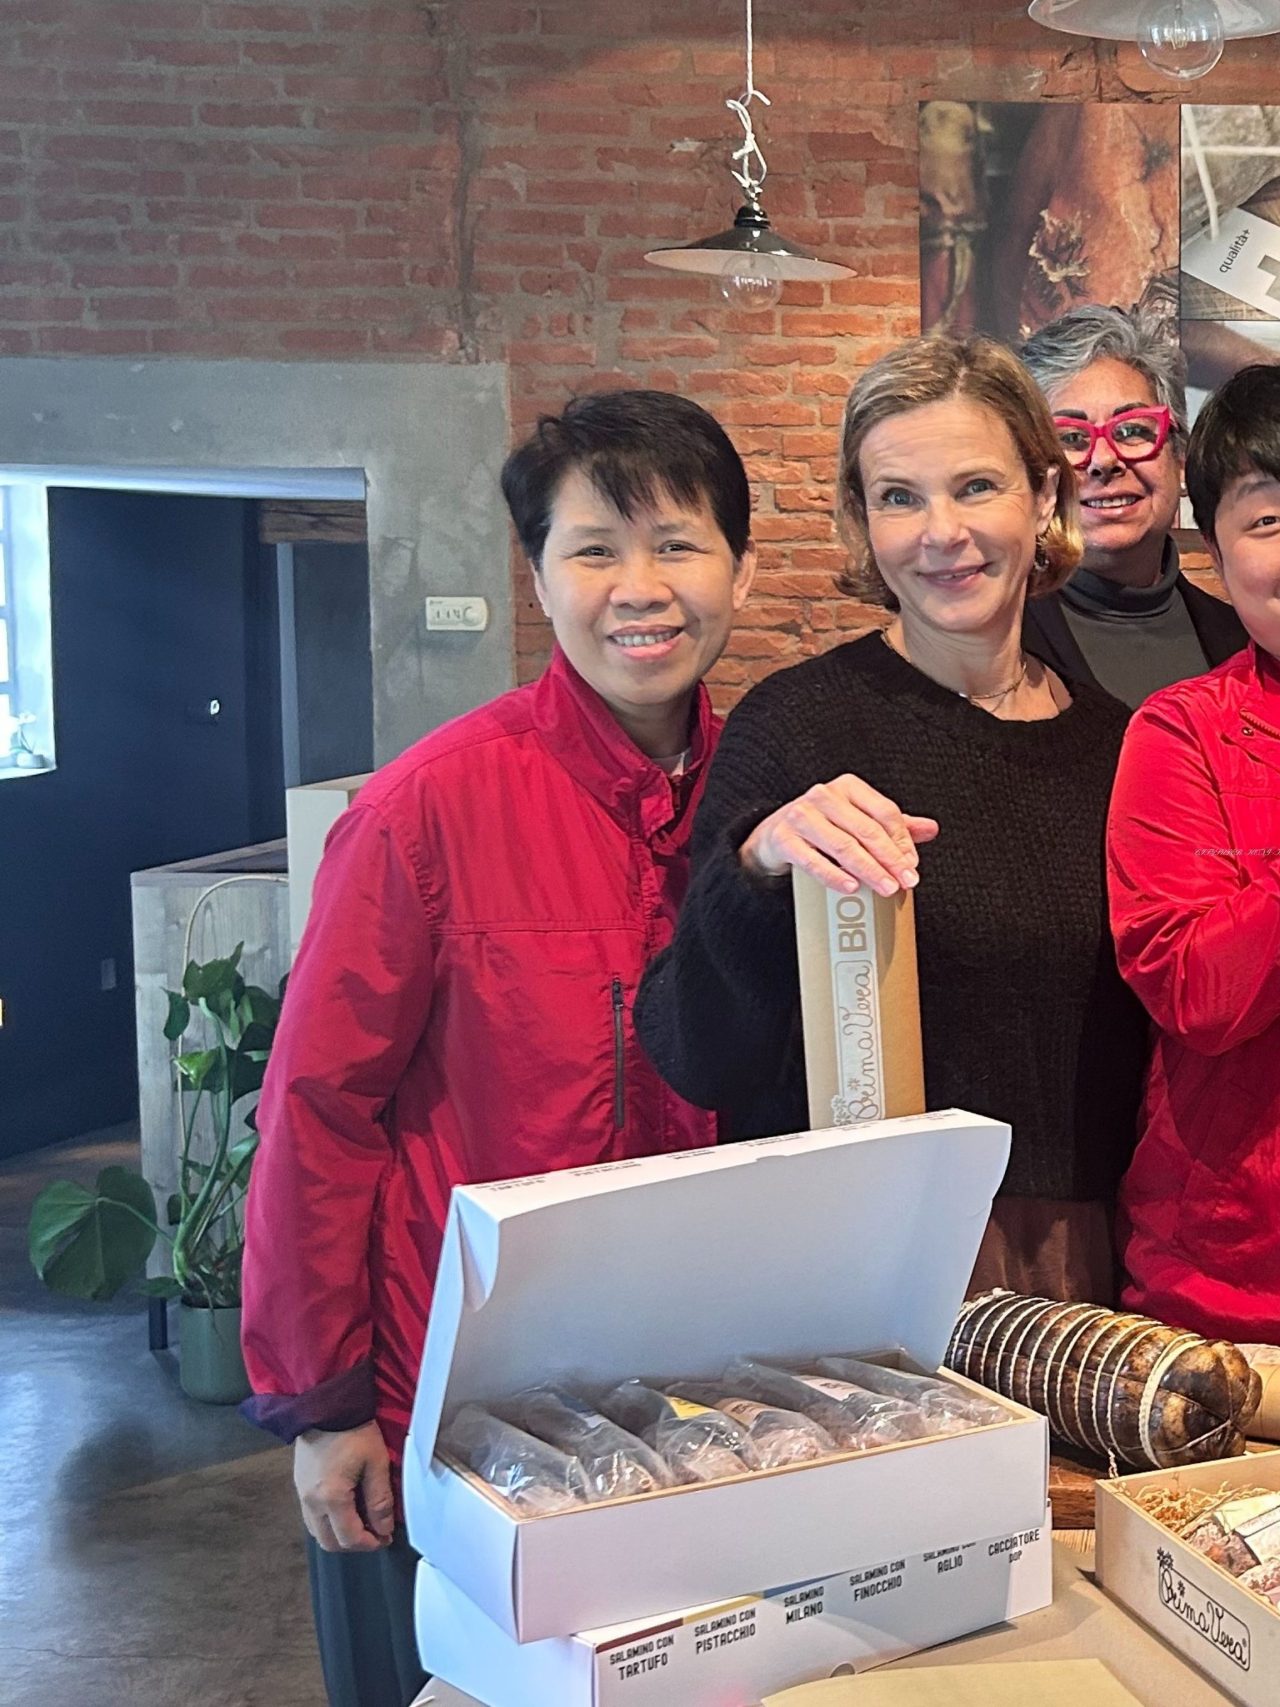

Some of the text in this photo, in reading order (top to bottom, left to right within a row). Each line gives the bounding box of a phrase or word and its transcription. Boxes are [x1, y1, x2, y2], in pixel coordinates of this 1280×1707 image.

[835, 895, 868, 953] BIO
[988, 1529, 1040, 1557] CACCIATORE
[937, 1555, 963, 1574] AGLIO
[1008, 1550, 1023, 1564] DOP
[849, 1559, 906, 1586] SALAMINO CON
[784, 1586, 824, 1608] SALAMINO
[853, 1575, 903, 1602] FINOCCHIO
[694, 1608, 756, 1638] SALAMINO CON
[785, 1601, 823, 1625] MILANO
[609, 1634, 674, 1666] SALAMINO CON
[695, 1623, 756, 1655] PISTACCHIO
[618, 1652, 668, 1681] TARTUFO
